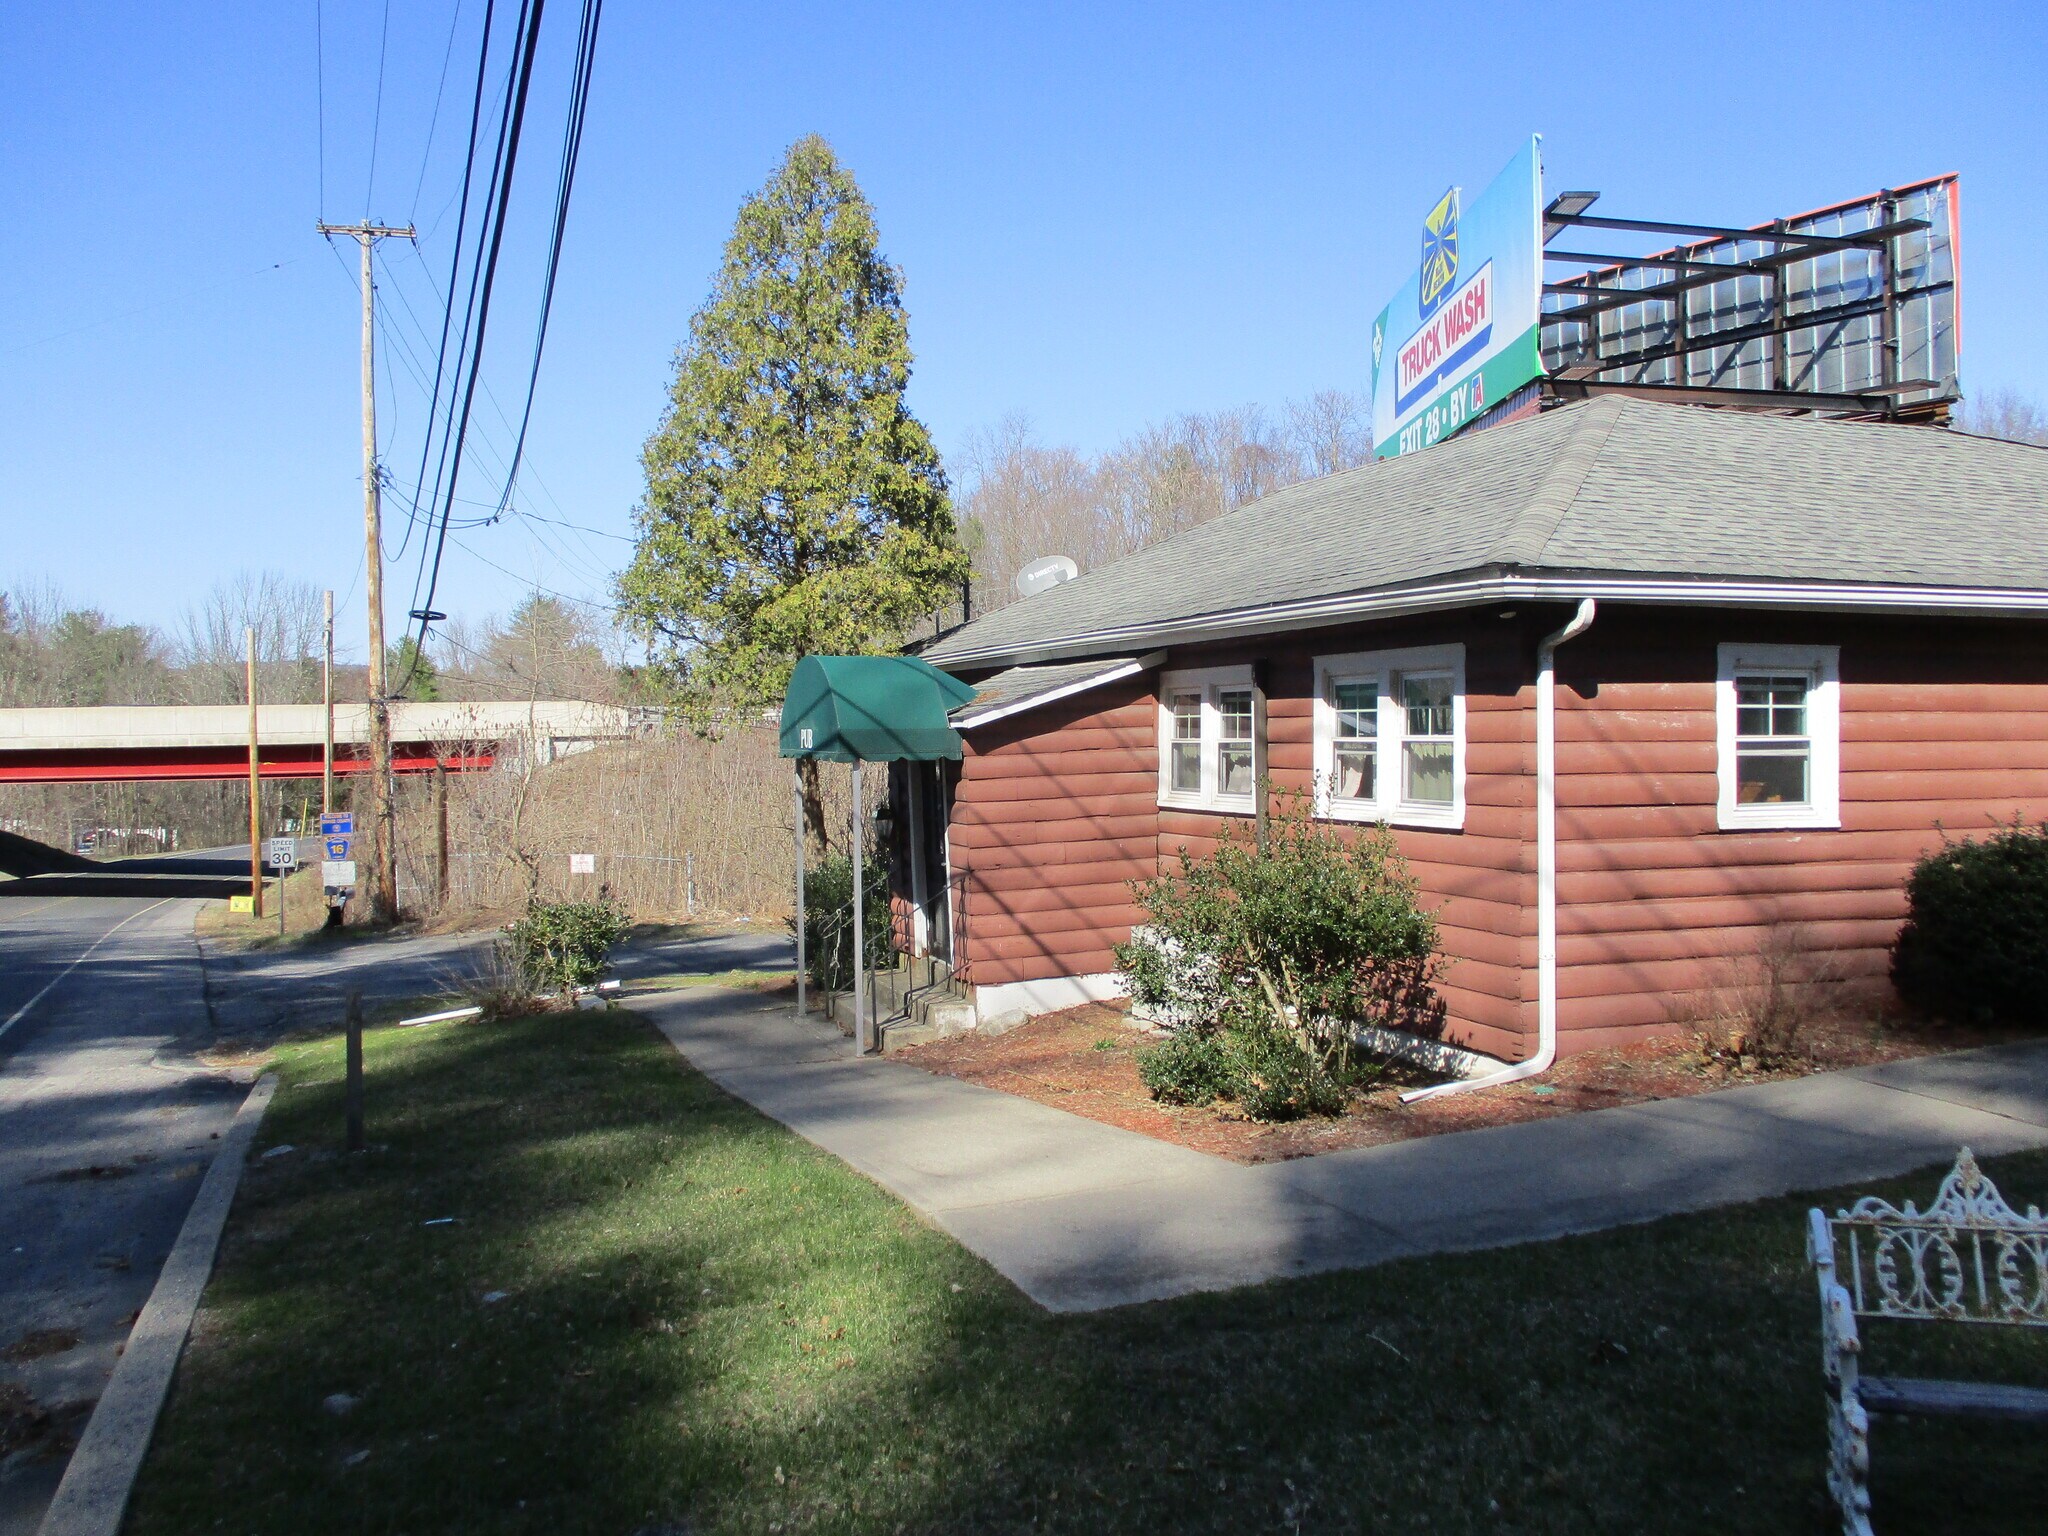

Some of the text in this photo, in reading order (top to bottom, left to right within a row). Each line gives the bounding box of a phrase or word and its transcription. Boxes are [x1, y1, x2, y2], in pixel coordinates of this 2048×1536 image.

[1402, 278, 1486, 387] TRUCK WASH
[1399, 416, 1423, 456] EXIT
[1425, 406, 1440, 446] 28
[1450, 383, 1468, 428] BY
[1034, 563, 1059, 579] DIRECTV
[800, 728, 813, 749] PUB
[331, 844, 344, 854] 16
[272, 853, 292, 865] 30
